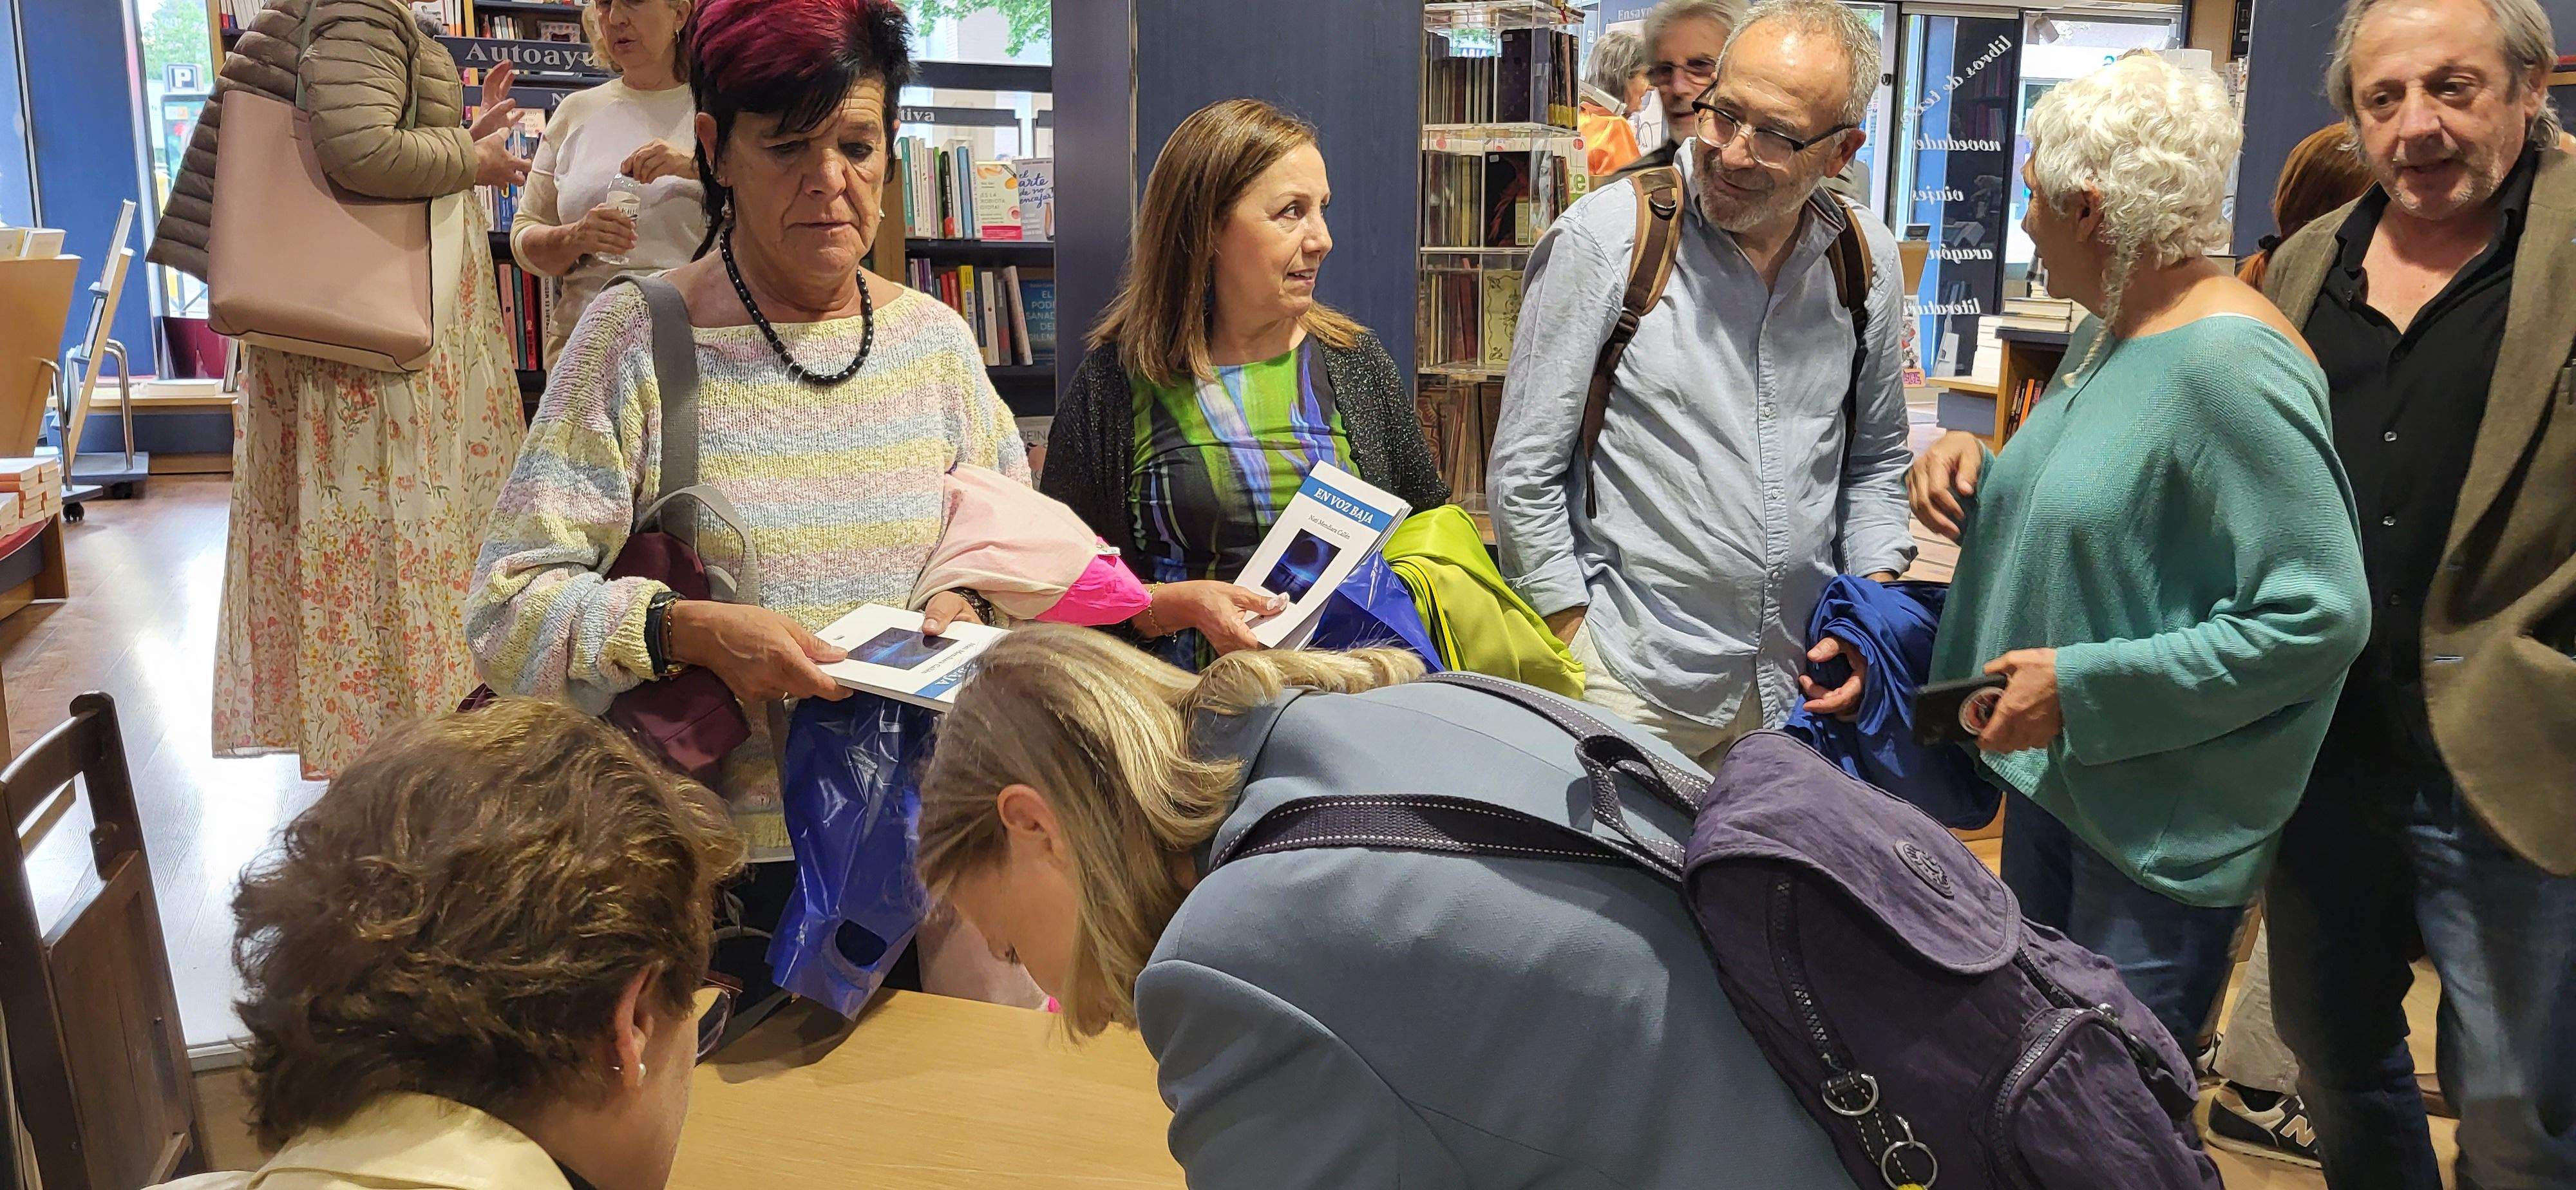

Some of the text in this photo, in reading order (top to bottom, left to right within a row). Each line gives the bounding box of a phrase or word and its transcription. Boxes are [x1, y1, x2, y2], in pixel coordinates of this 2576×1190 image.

[1019, 173, 1049, 187] arte
[1314, 487, 1374, 524] EN VOZ BAJA
